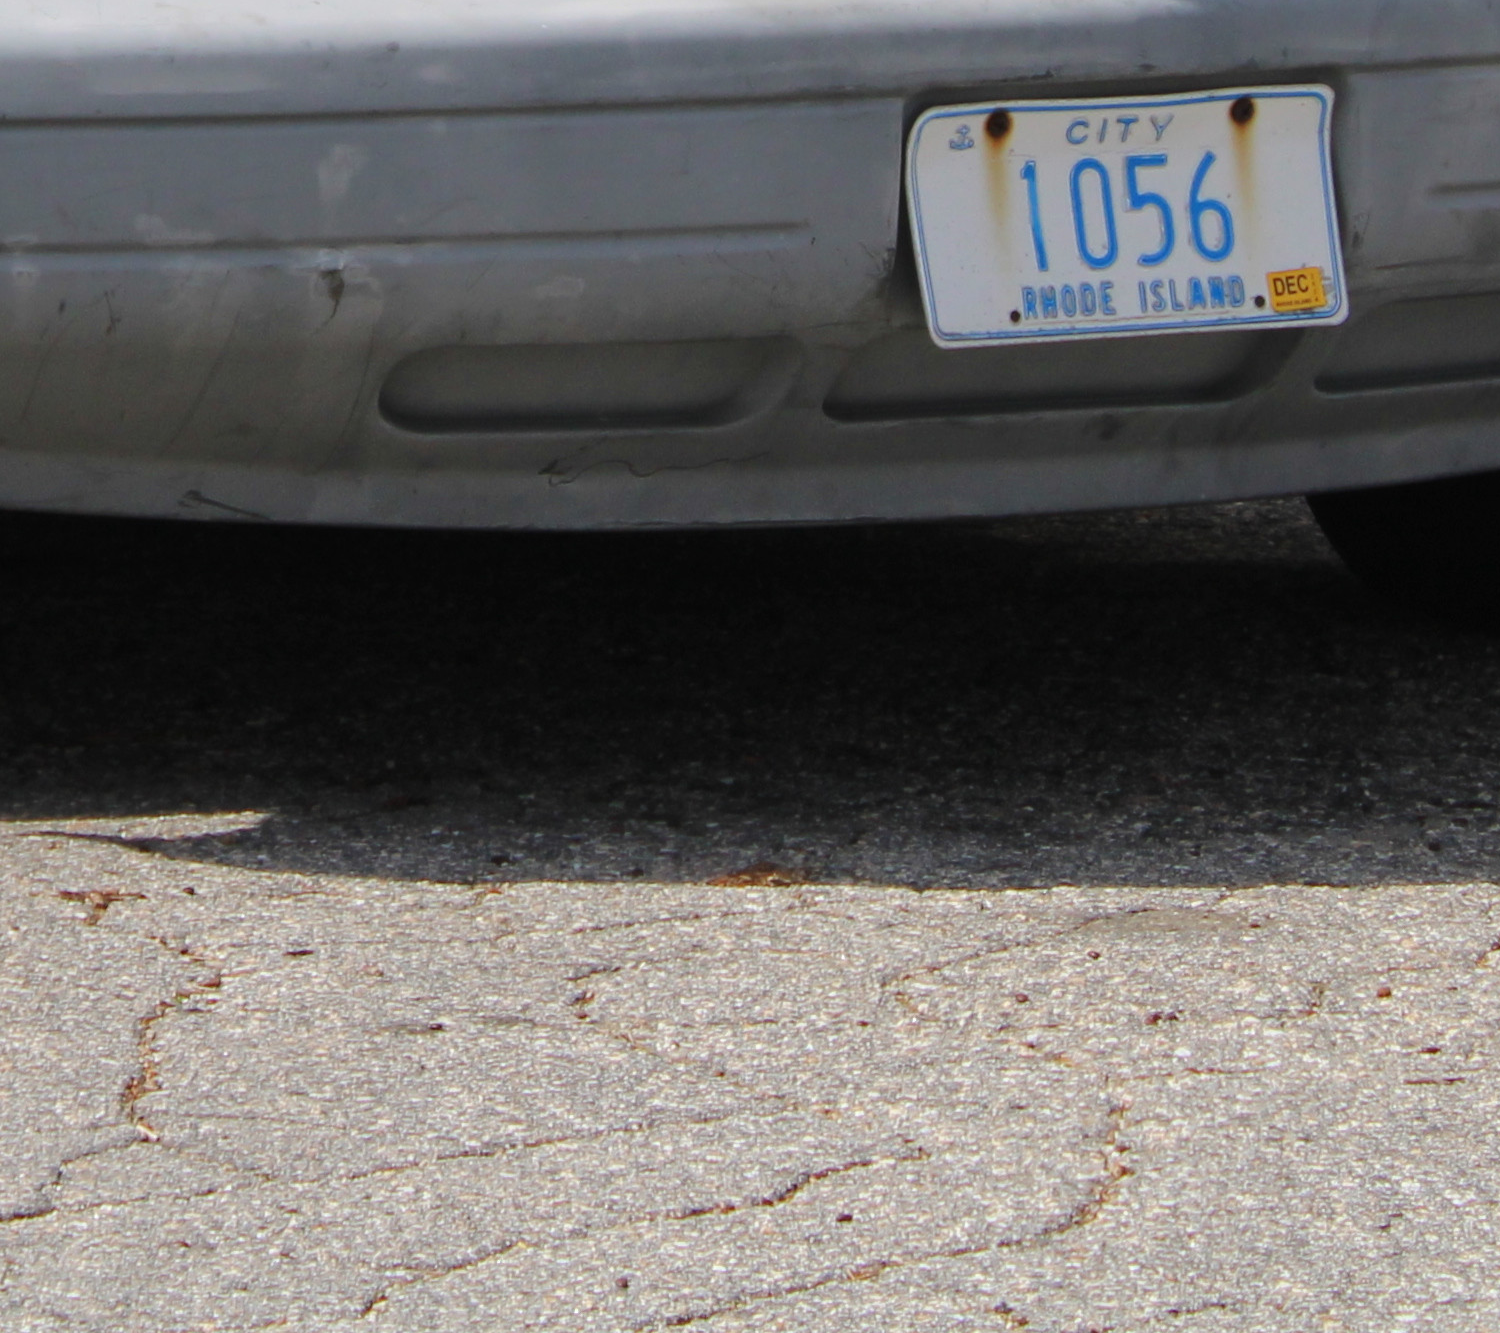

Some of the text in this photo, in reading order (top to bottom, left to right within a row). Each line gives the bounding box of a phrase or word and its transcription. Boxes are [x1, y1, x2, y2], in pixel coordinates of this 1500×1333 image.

[1065, 113, 1174, 146] CITY
[1020, 150, 1235, 272] 1056
[1021, 274, 1246, 320] RHODE ISLAND
[1272, 273, 1309, 296] DEC
